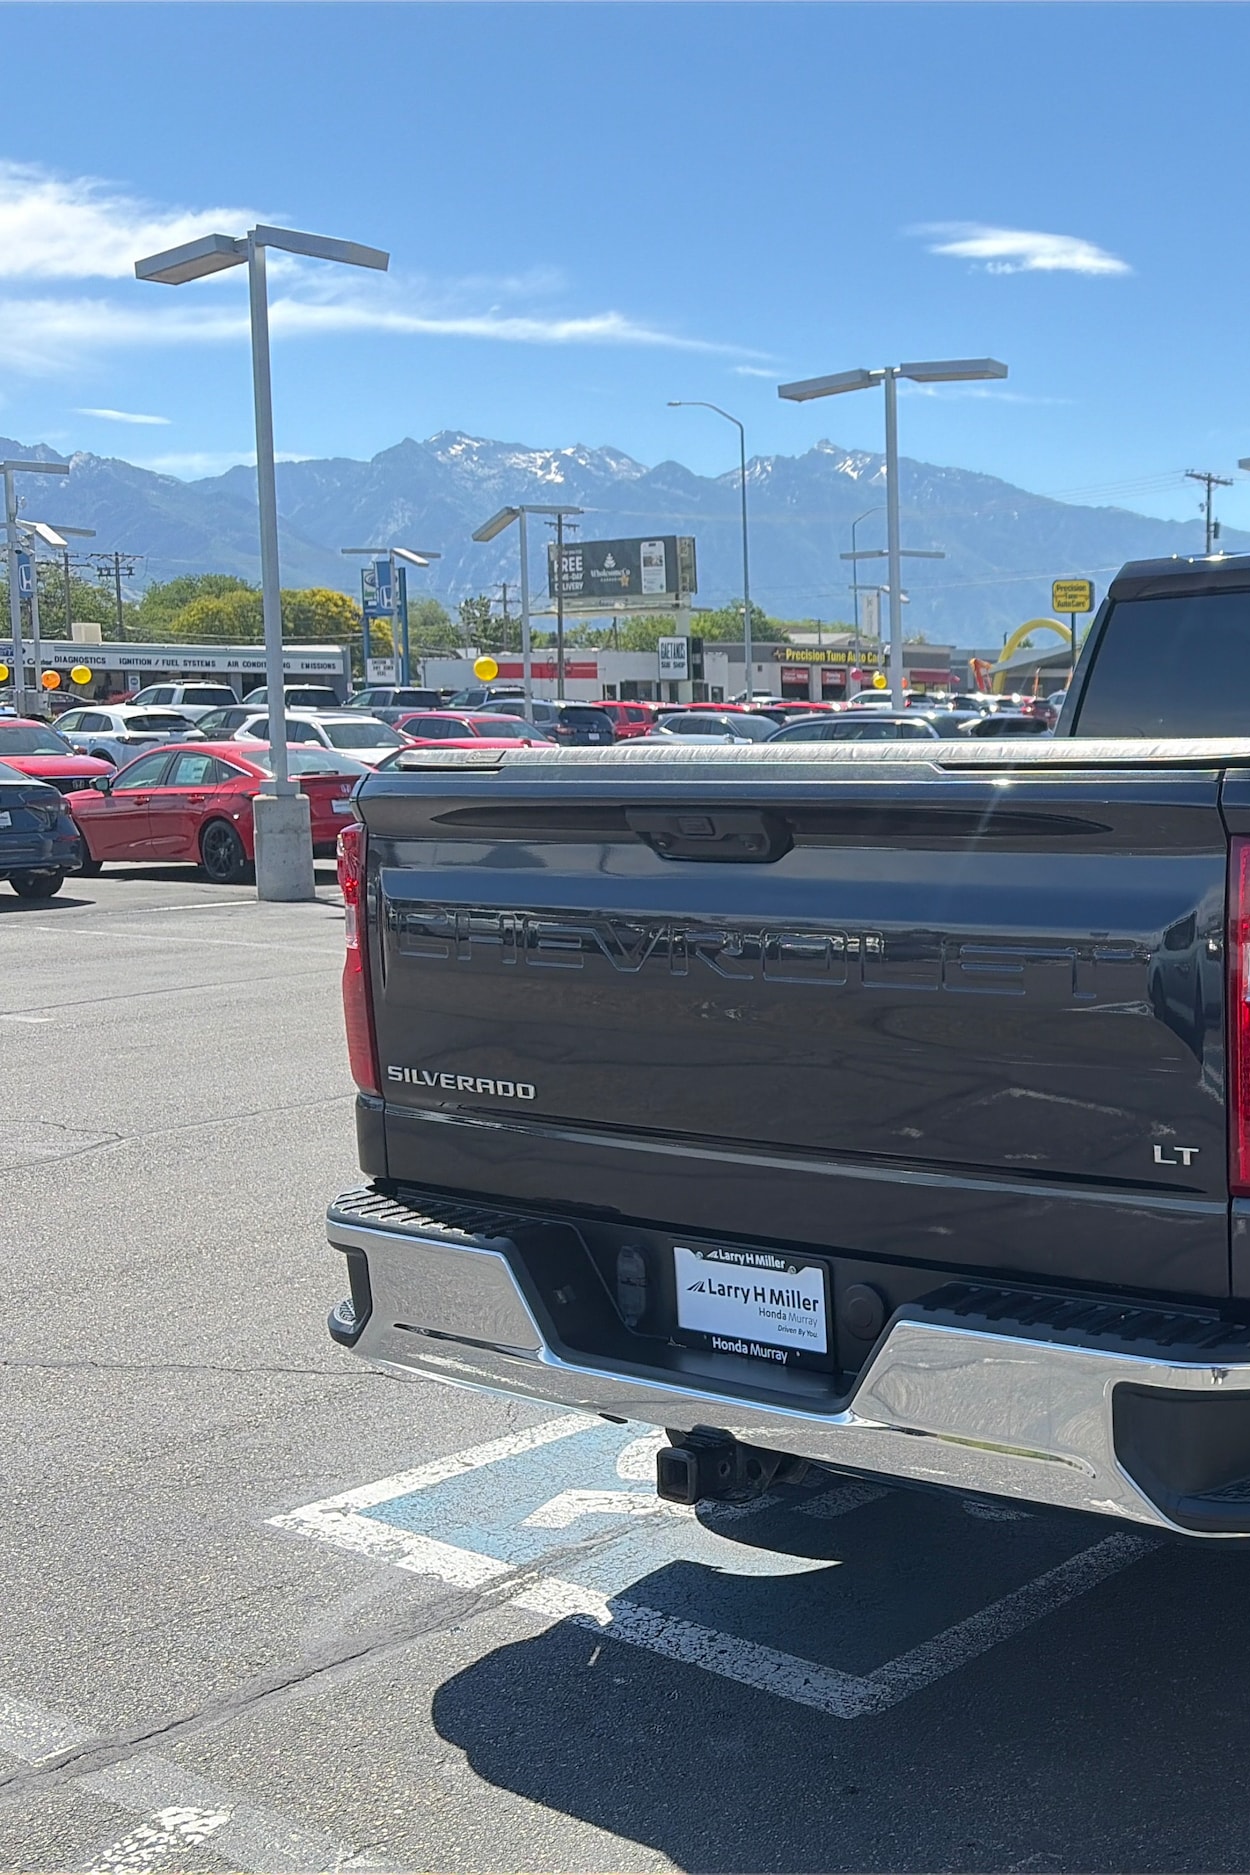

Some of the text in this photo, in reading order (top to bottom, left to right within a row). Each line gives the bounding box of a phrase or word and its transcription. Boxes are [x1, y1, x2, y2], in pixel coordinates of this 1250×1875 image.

[54, 656, 107, 665] DIAGNOSTICS
[119, 657, 152, 666] IGNITION
[161, 659, 180, 667] FUEL
[182, 659, 216, 668] SYSTEMS
[227, 660, 239, 668] AIR
[785, 648, 825, 663] Precision
[826, 650, 846, 663] Tune
[396, 905, 1144, 1000] CHEVROLET
[387, 1064, 537, 1100] SILVERADO
[1153, 1144, 1200, 1166] LT
[719, 1249, 786, 1269] Larry H Miller
[708, 1278, 819, 1312] Larry H Miller
[759, 1306, 818, 1328] Honda Murray
[777, 1324, 797, 1335] Driven
[798, 1328, 805, 1337] By
[712, 1335, 788, 1364] Honda Murray
